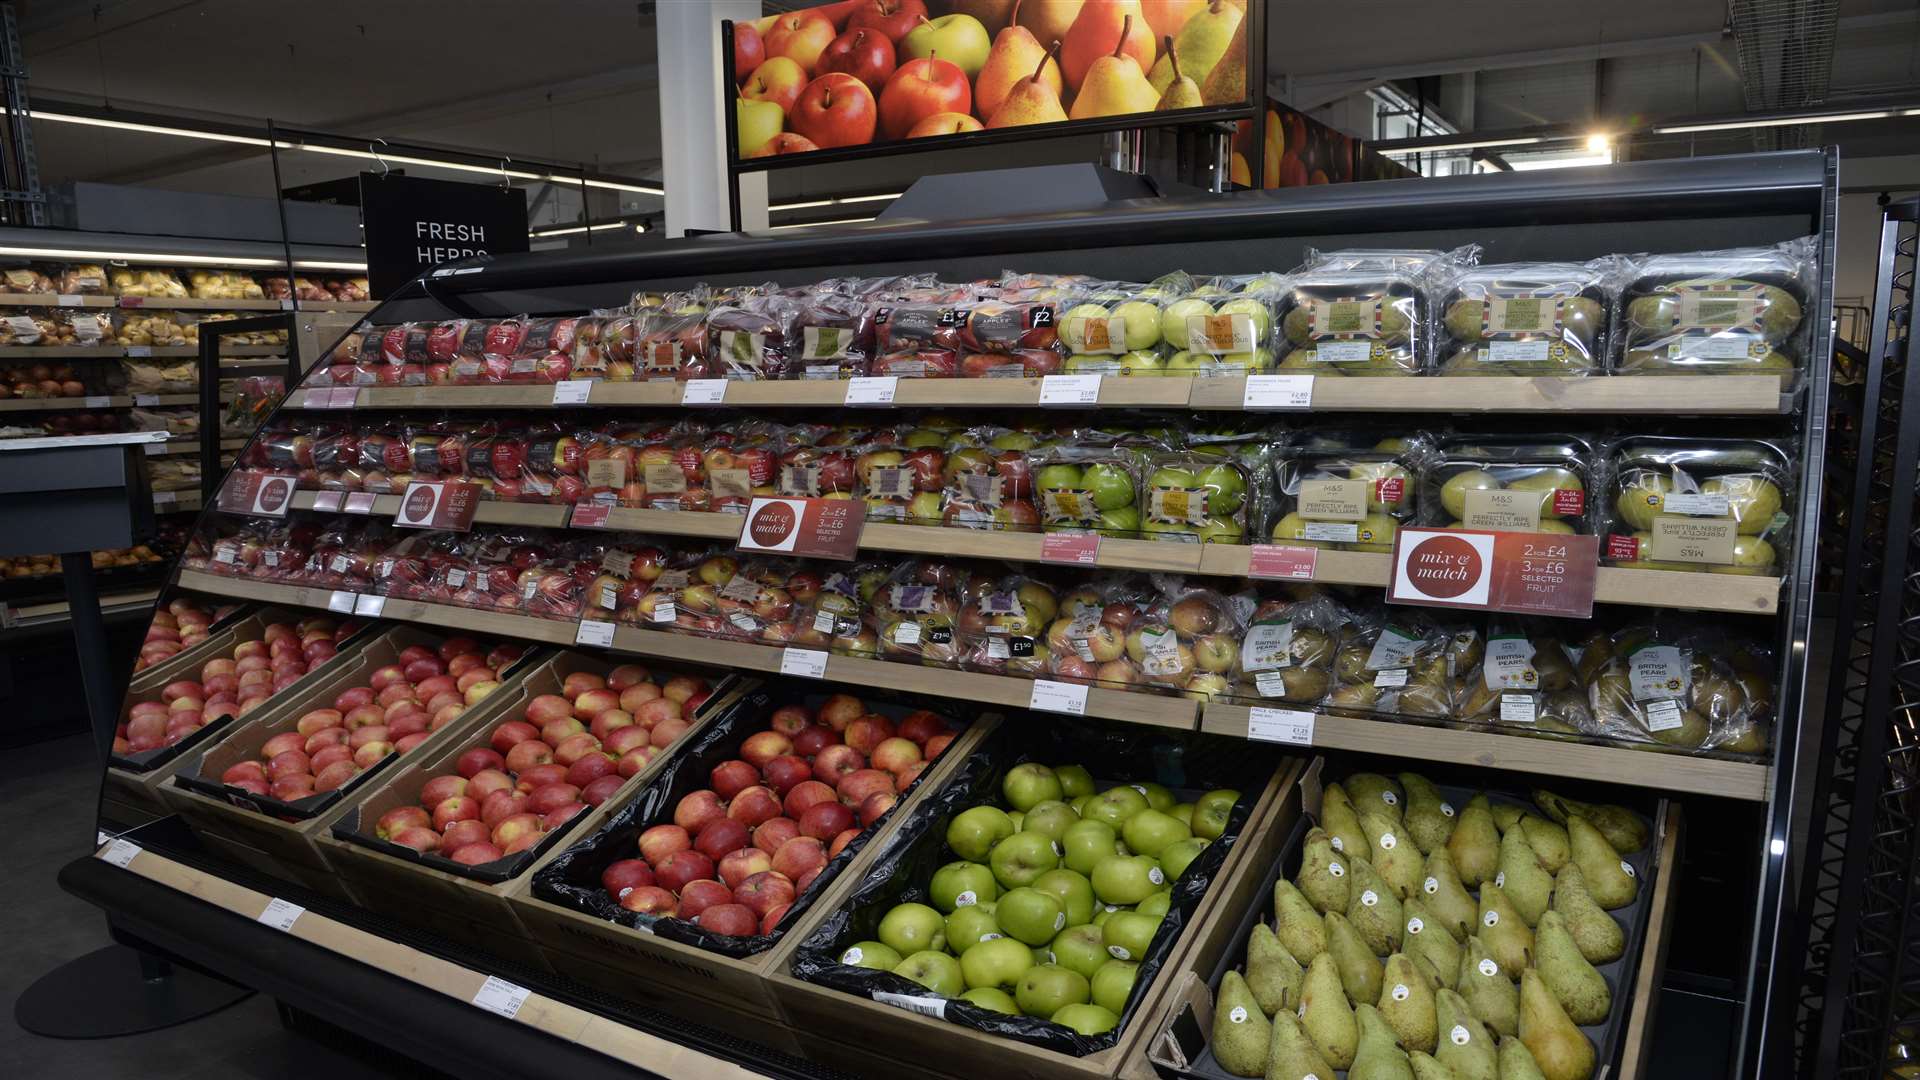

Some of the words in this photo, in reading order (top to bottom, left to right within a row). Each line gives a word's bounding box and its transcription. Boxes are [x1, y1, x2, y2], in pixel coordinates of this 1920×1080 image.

[416, 222, 484, 242] FRESH
[1491, 495, 1513, 503] M&S
[760, 512, 781, 522] mix
[835, 507, 848, 517] £4
[755, 523, 787, 534] match
[818, 518, 825, 528] 3
[832, 519, 844, 529] £6
[1524, 544, 1534, 556] 2
[1547, 545, 1567, 558] £4
[1680, 549, 1704, 558] M&S
[1420, 550, 1455, 564] mix
[1457, 554, 1471, 566] &
[1521, 560, 1532, 572] 3
[1545, 561, 1565, 574] £6
[1417, 566, 1468, 581] match
[1521, 574, 1564, 584] SELECTED
[1526, 583, 1557, 593] FRUIT
